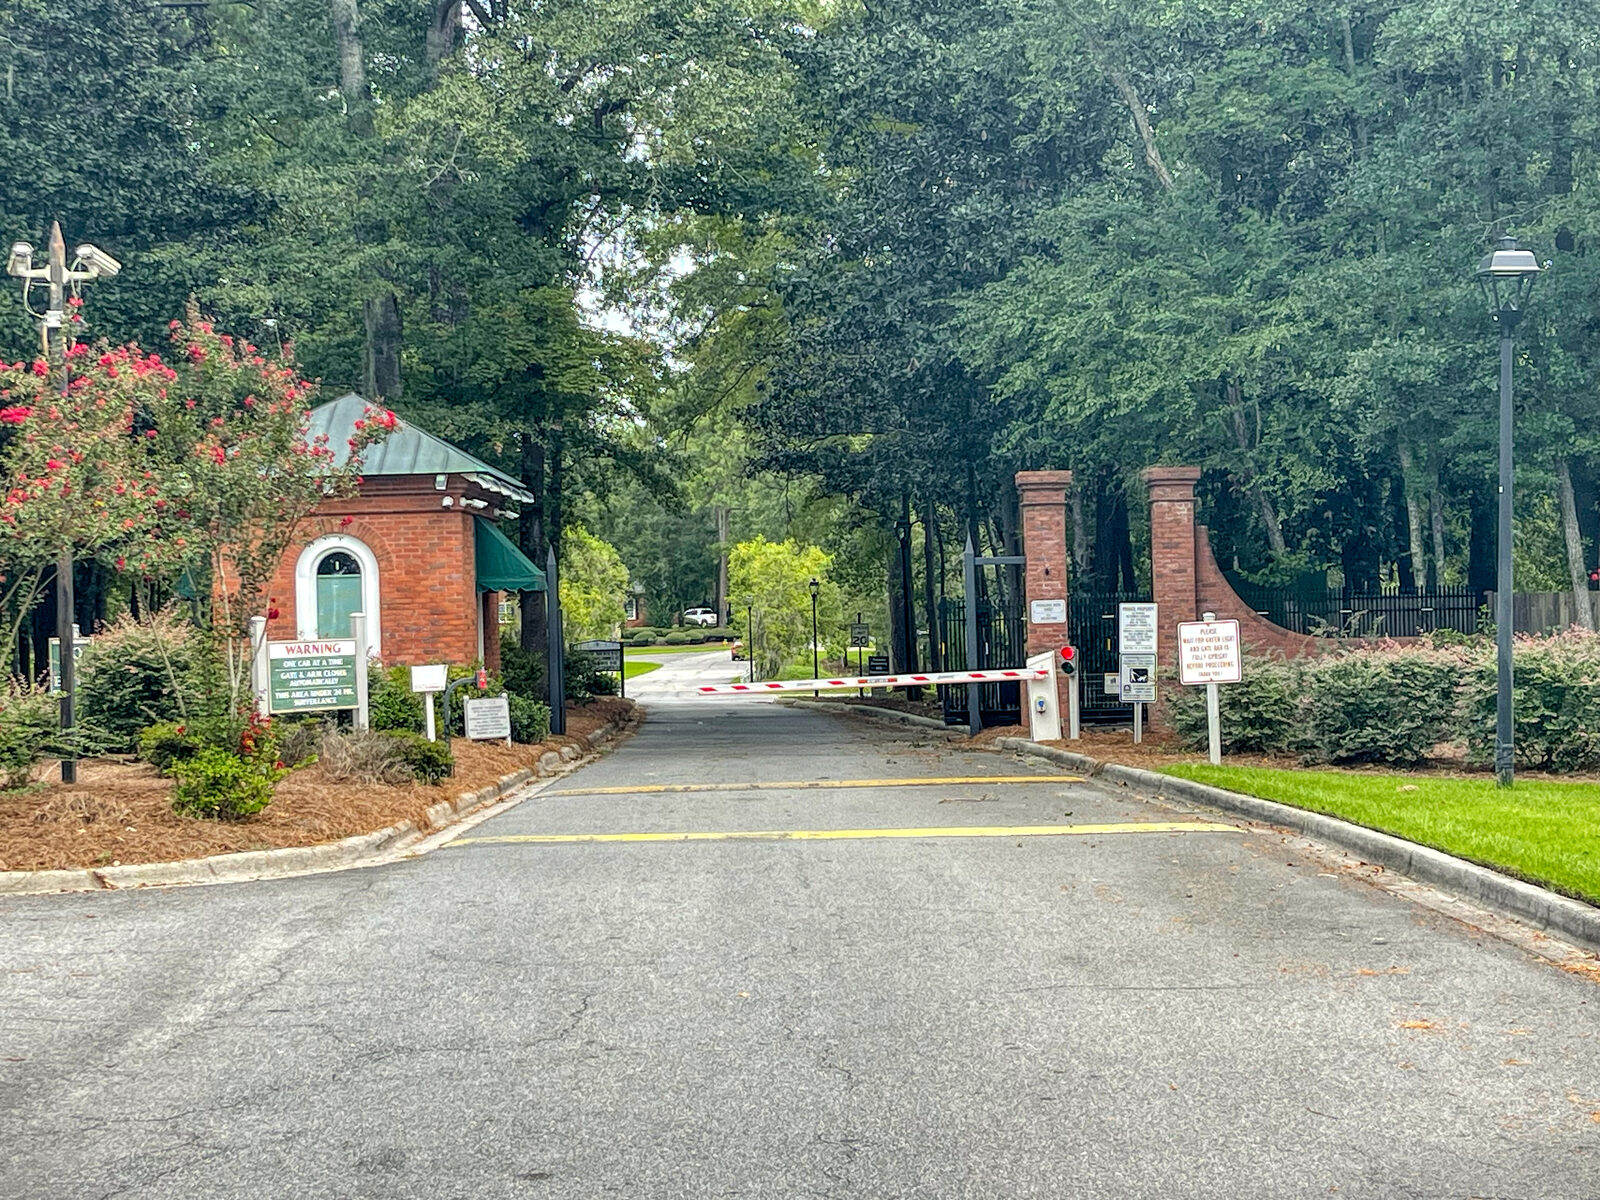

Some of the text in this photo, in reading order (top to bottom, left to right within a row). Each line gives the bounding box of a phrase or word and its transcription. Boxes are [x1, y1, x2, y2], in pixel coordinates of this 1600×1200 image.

[853, 636, 867, 645] 20
[285, 643, 341, 654] WARNING
[283, 660, 296, 668] ONE
[328, 658, 343, 666] TIME
[280, 672, 298, 680] GATE
[307, 670, 322, 678] ARM
[290, 678, 339, 687] AUTOMATICALLY
